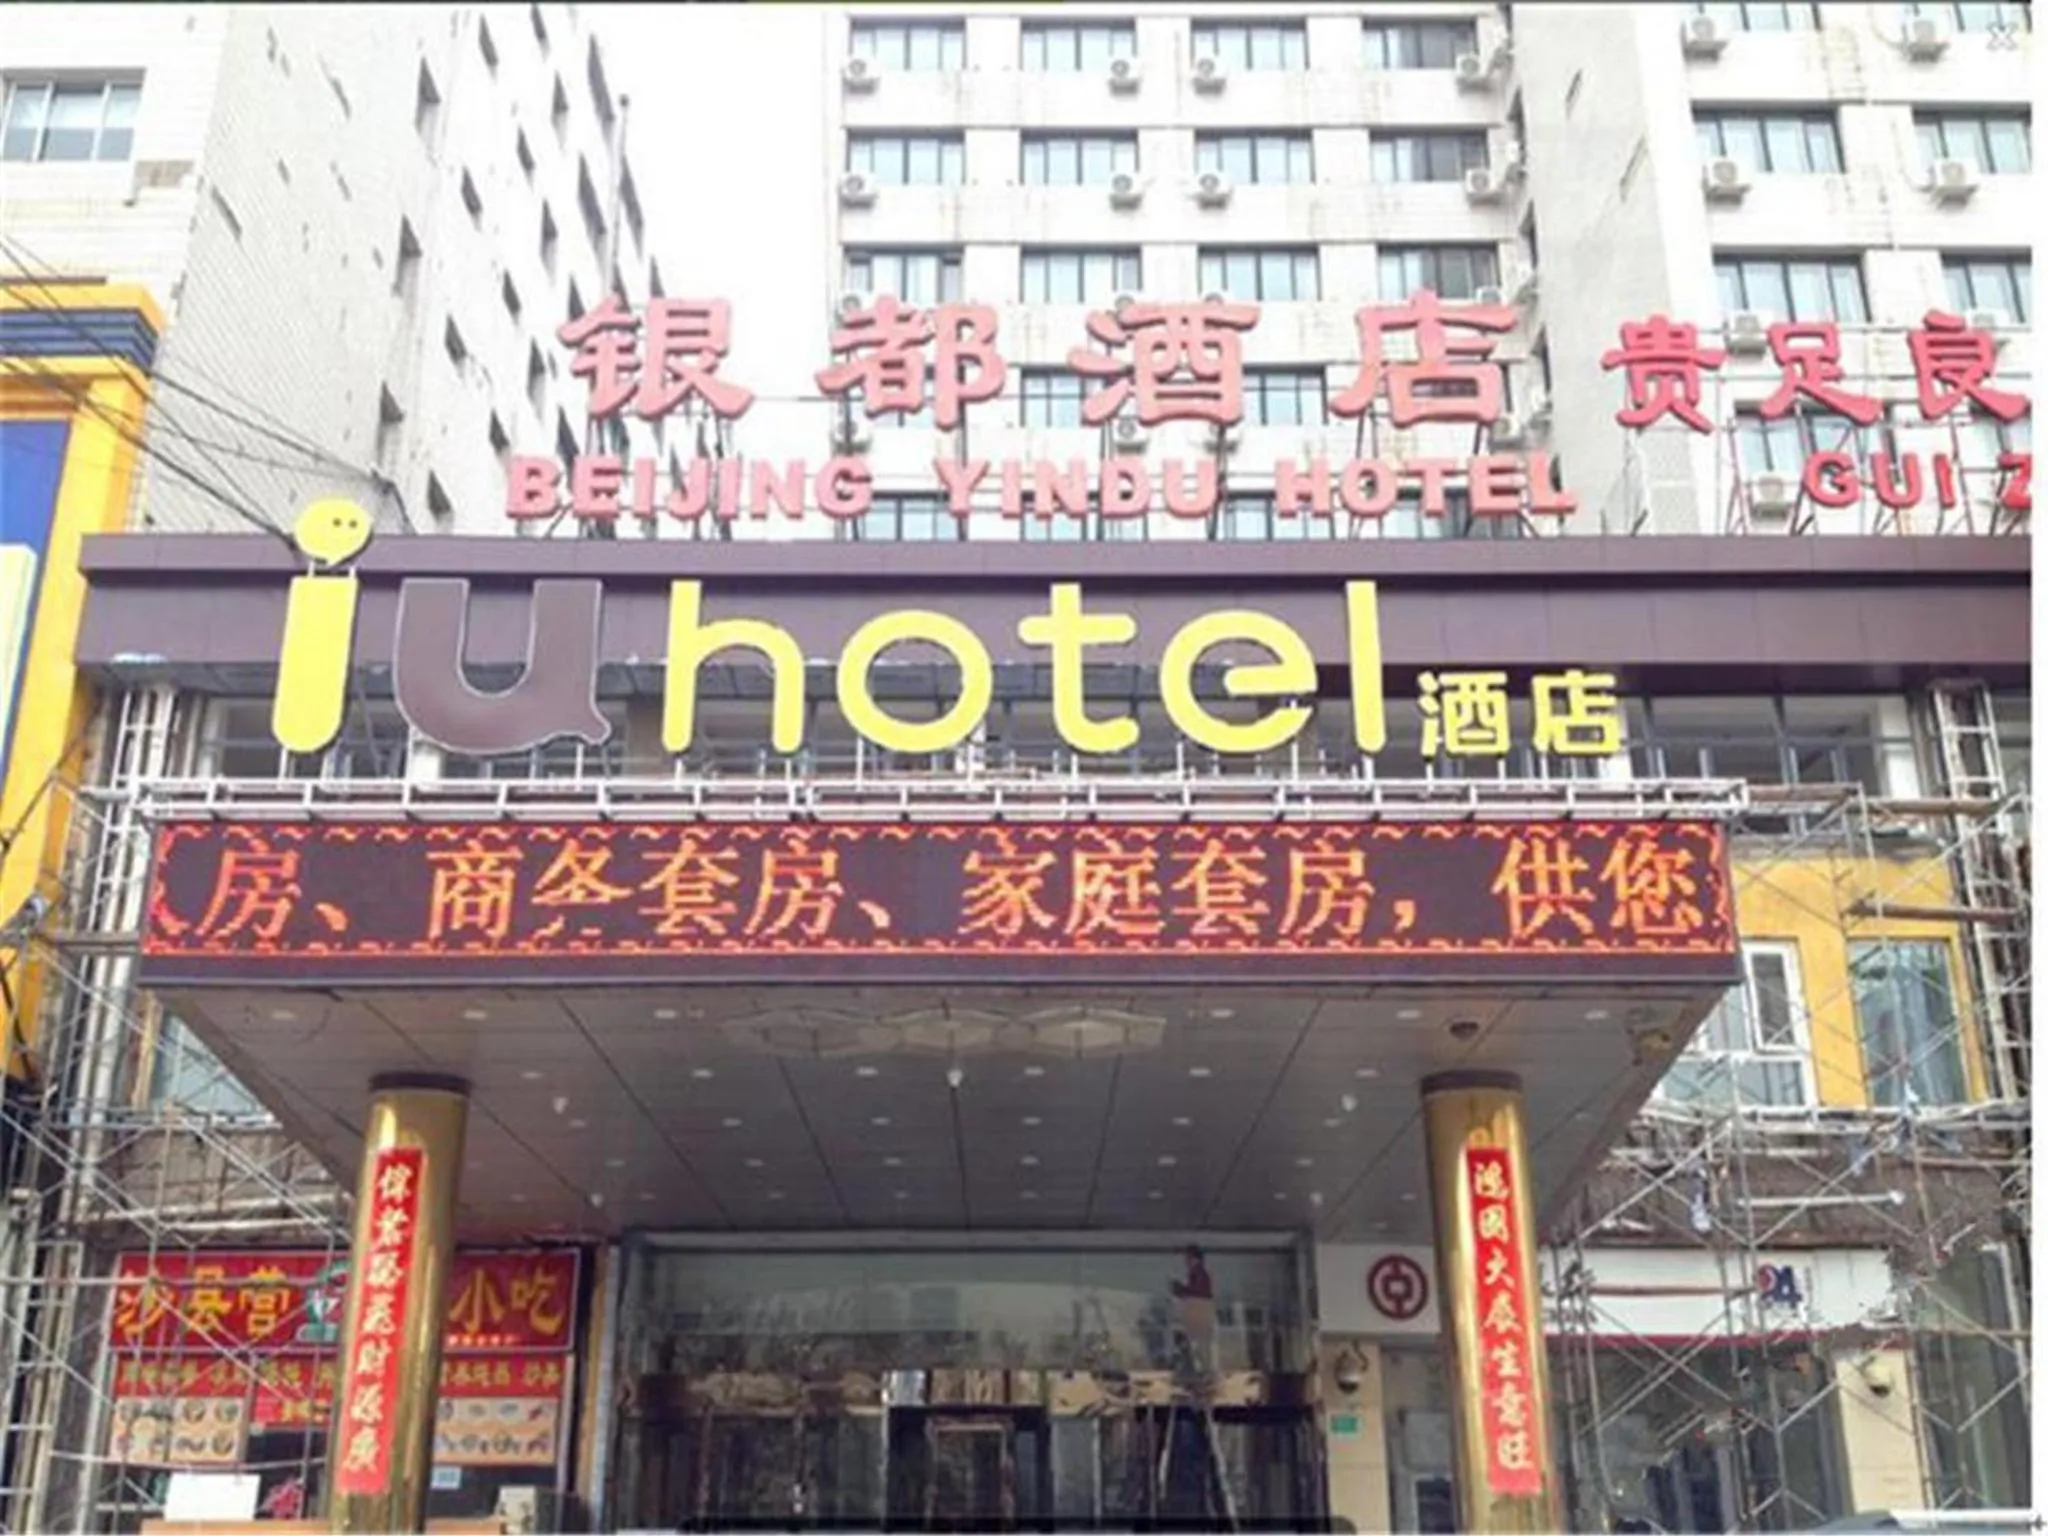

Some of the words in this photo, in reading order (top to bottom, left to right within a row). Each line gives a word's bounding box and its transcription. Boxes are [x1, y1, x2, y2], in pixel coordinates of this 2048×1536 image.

[557, 289, 1518, 431] 银都酒店
[1600, 309, 2031, 435] 贵足良
[506, 455, 873, 521] BEIJING
[934, 454, 1219, 521] YINDU
[1274, 450, 1579, 519] HOTEL
[1803, 451, 1957, 509] GUI
[1417, 669, 1623, 758] 酒店
[448, 1266, 566, 1333] 小吃
